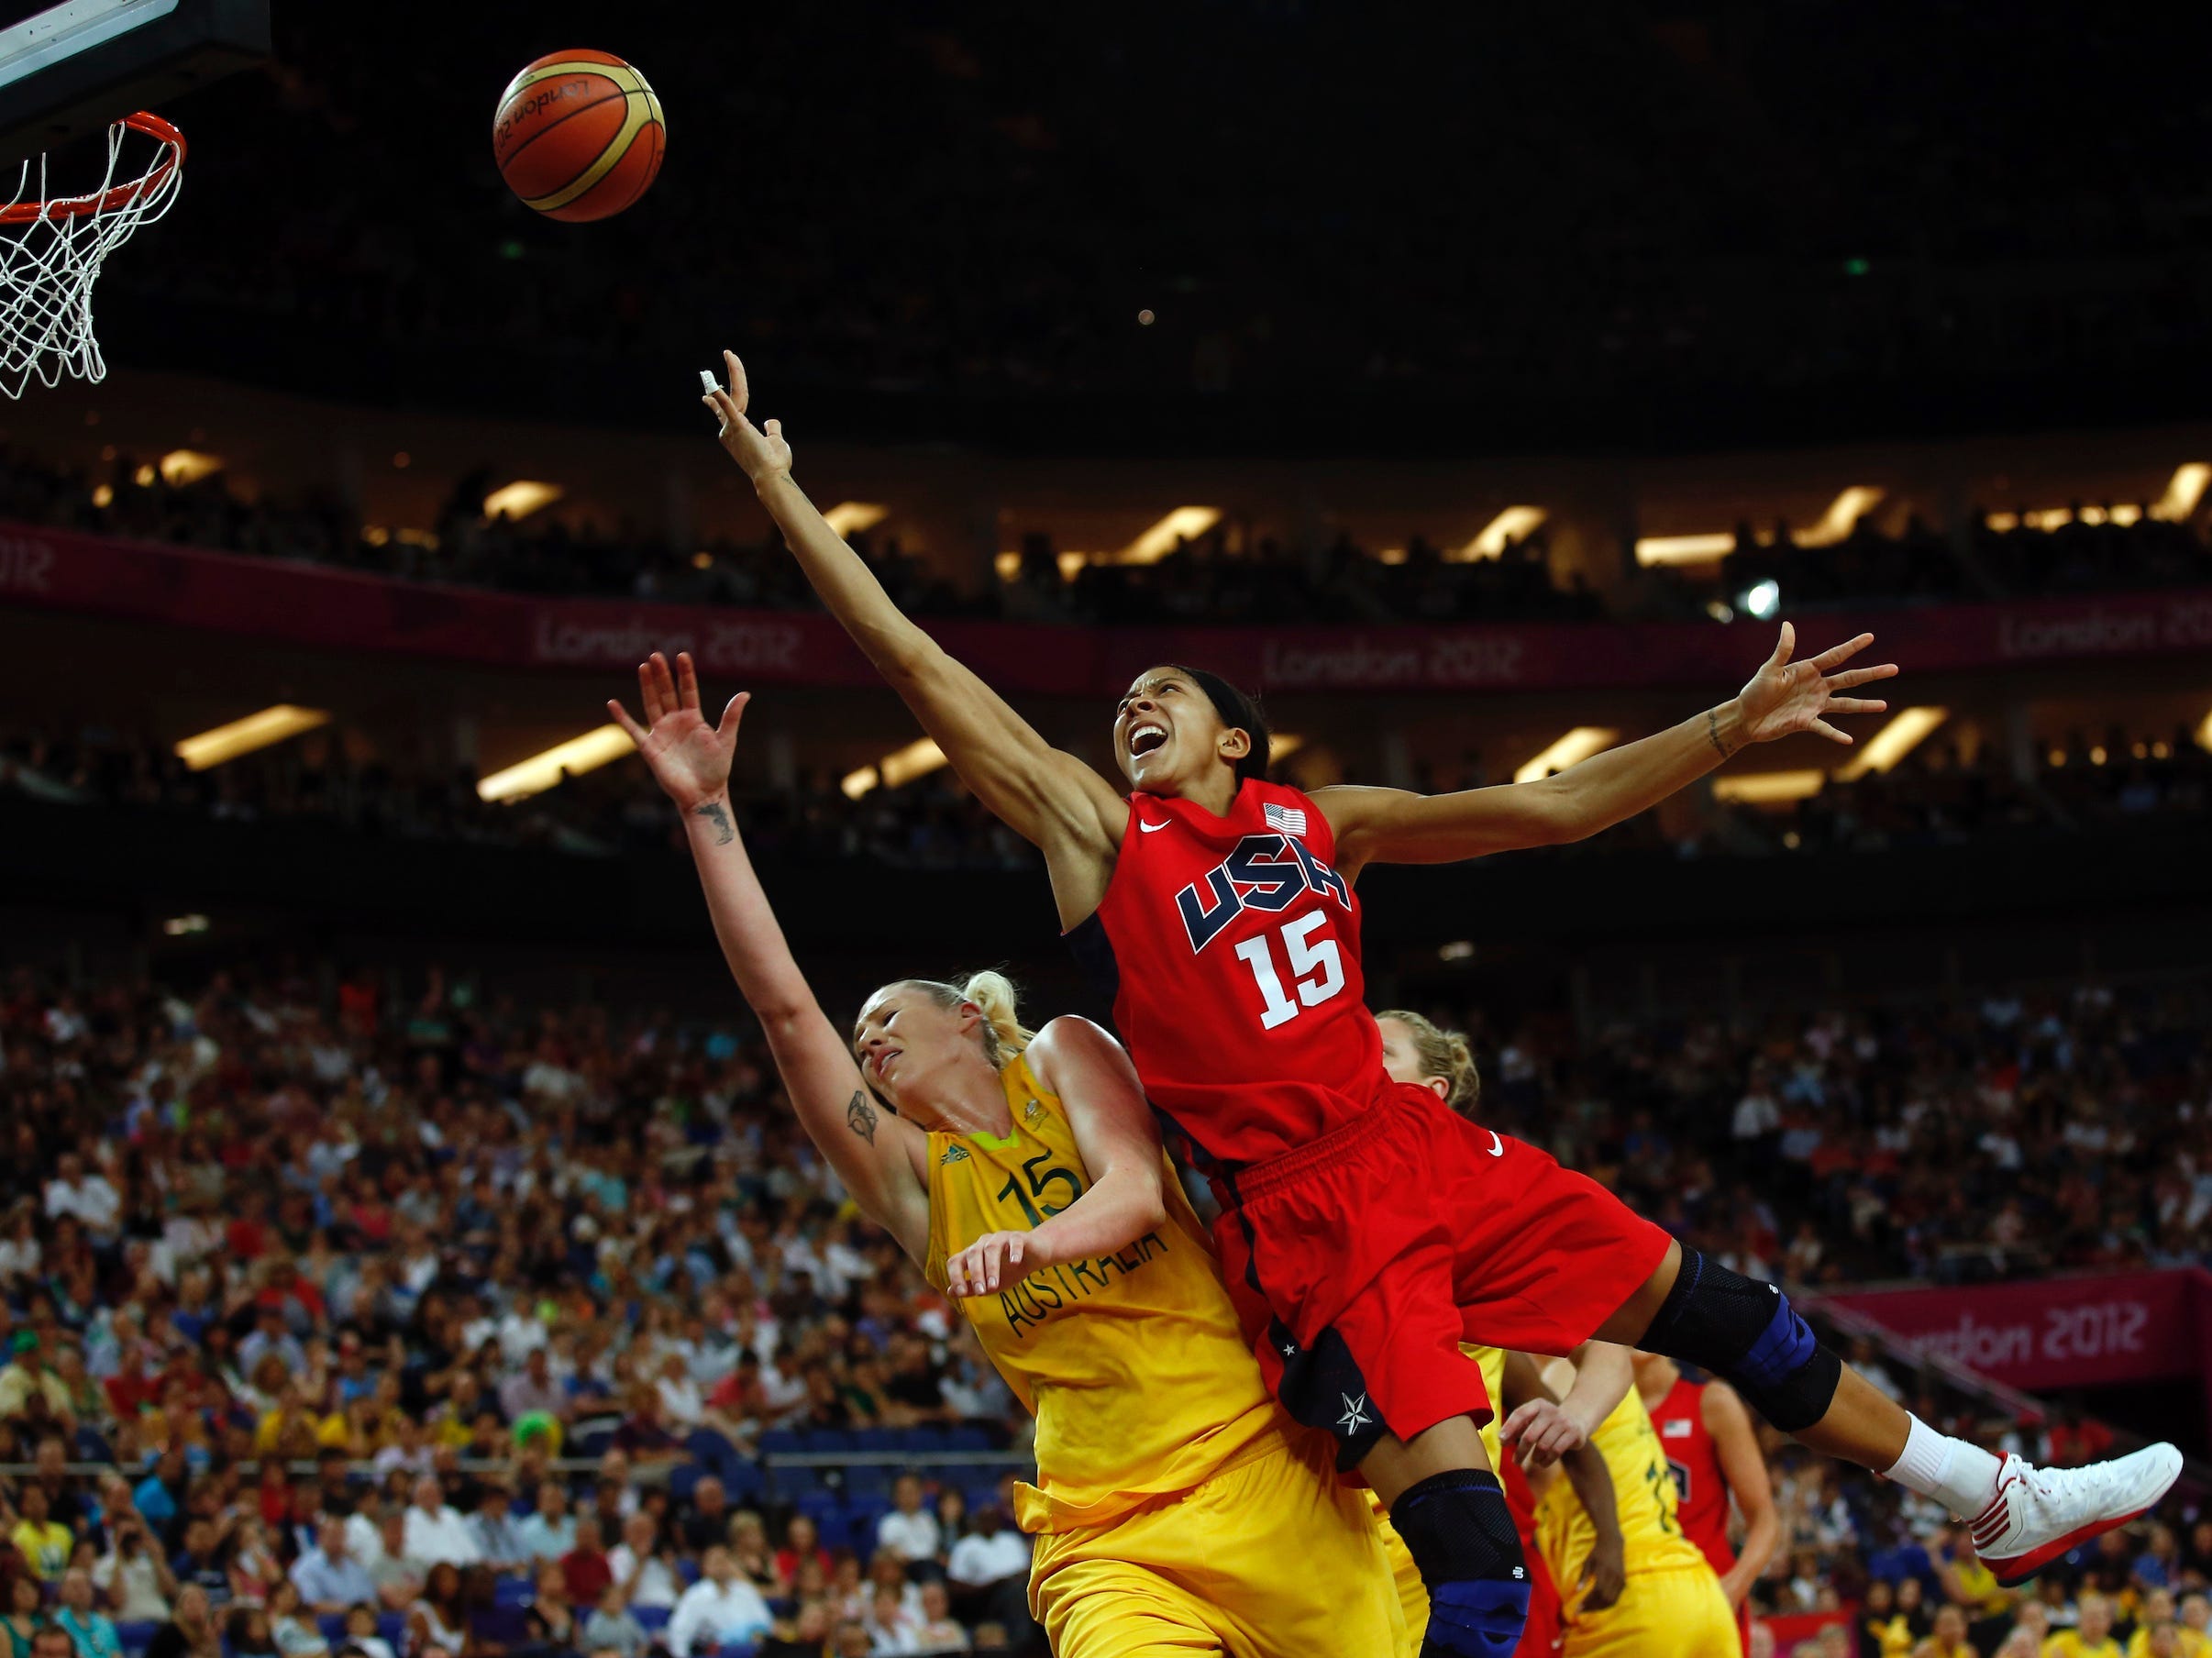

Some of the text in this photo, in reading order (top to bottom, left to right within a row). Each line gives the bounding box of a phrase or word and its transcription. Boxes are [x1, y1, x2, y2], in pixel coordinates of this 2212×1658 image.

[514, 80, 589, 124] London
[536, 611, 804, 672] London 2012
[1263, 635, 1521, 686] London 2012
[1998, 605, 2157, 658] London
[1175, 834, 1353, 955] USA
[1234, 908, 1345, 1031] 15
[997, 1148, 1082, 1228] 15
[999, 1232, 1168, 1339] AUSTRALIA
[2041, 1300, 2149, 1361] 2012
